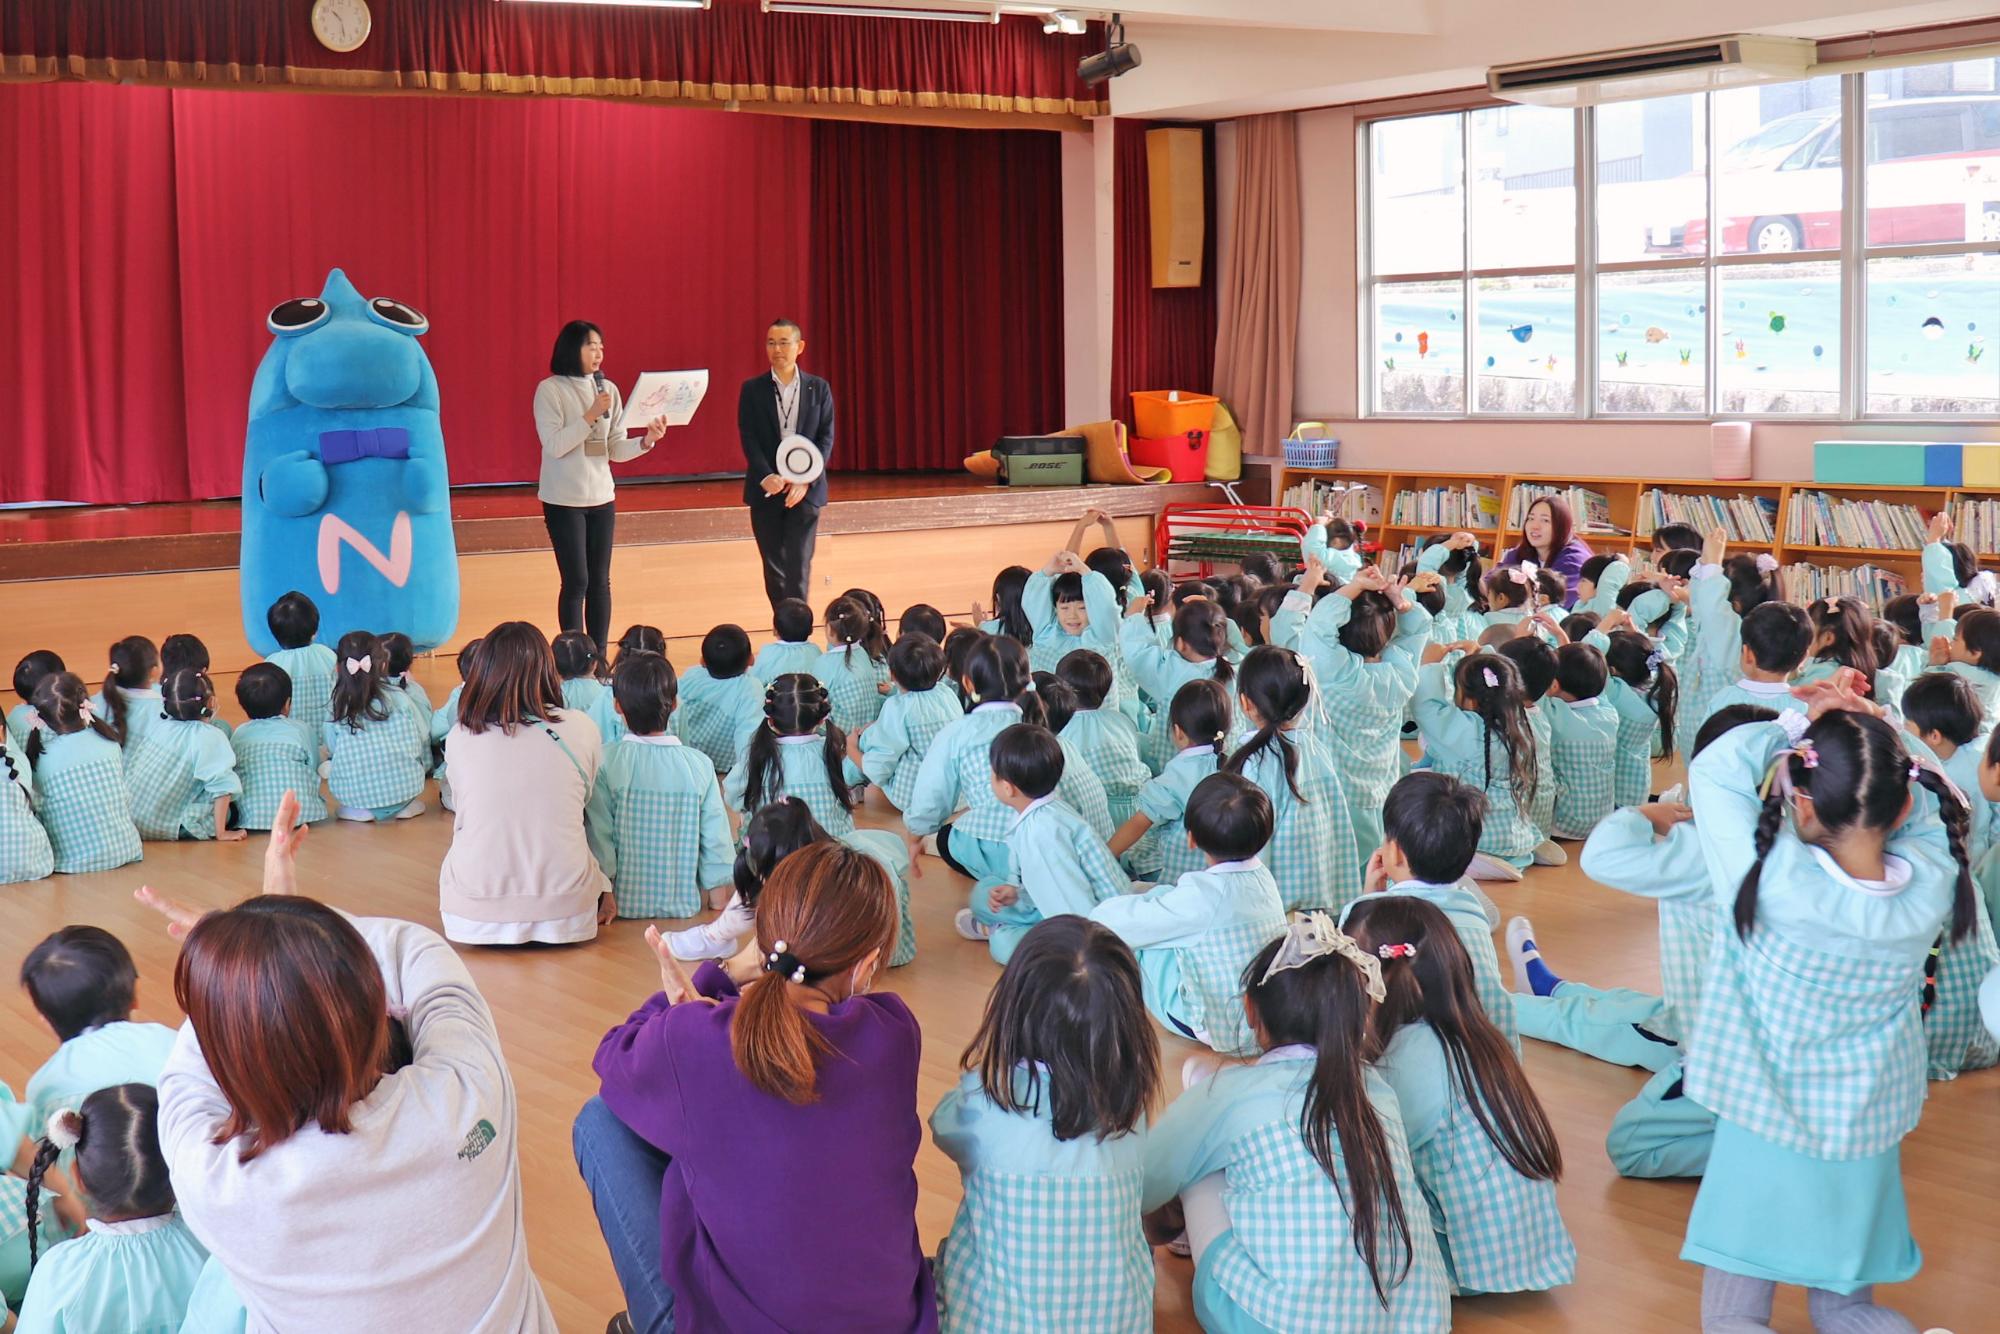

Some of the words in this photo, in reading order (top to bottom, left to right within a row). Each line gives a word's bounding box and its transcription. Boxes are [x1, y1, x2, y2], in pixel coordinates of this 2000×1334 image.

[1024, 461, 1068, 470] BOSE
[317, 510, 412, 595] N
[466, 1124, 480, 1142] THE
[457, 1133, 484, 1160] NORTH
[466, 1140, 487, 1163] FACE
